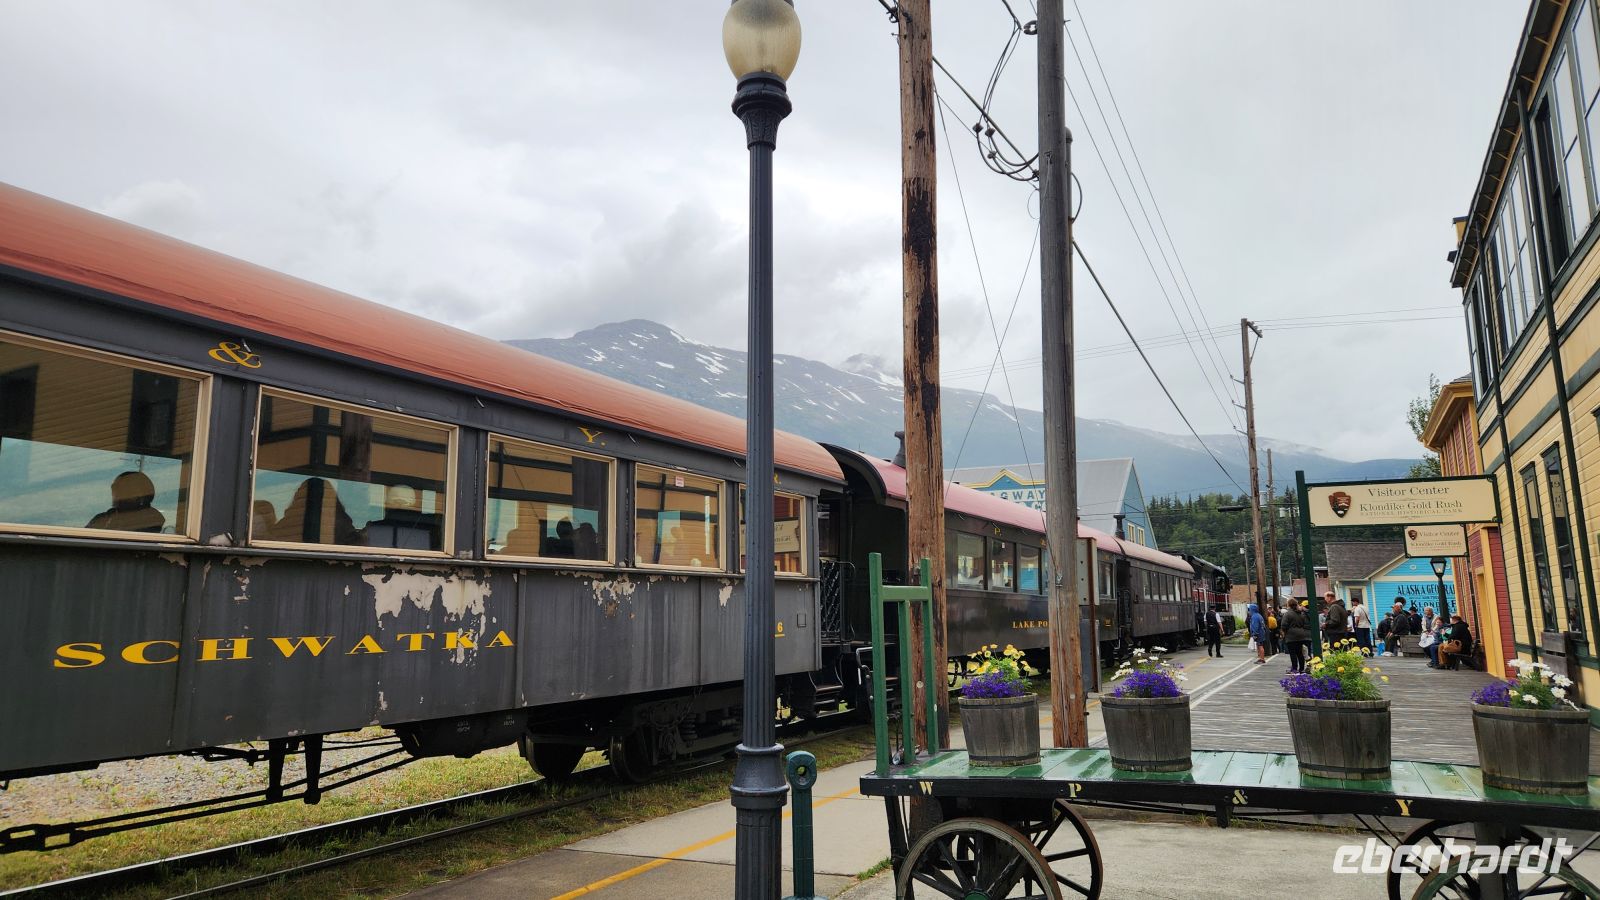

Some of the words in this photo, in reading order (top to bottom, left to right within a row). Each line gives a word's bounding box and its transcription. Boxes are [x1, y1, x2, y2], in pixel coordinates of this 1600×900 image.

[207, 341, 263, 369] &
[577, 426, 606, 446] Y.
[1368, 488, 1407, 497] Visitor
[1409, 487, 1450, 496] Center
[1360, 503, 1405, 512] Klondike
[1407, 501, 1431, 510] Gold
[1436, 500, 1463, 509] Rush
[1397, 584, 1426, 595] ALASKA
[1426, 584, 1456, 595] GEORA
[1012, 620, 1035, 629] LAKE
[1037, 620, 1049, 628] PO
[53, 630, 515, 669] SCHWATKA
[919, 781, 934, 796] W
[1067, 783, 1082, 798] P
[1231, 789, 1249, 805] &
[1395, 799, 1413, 816] Y
